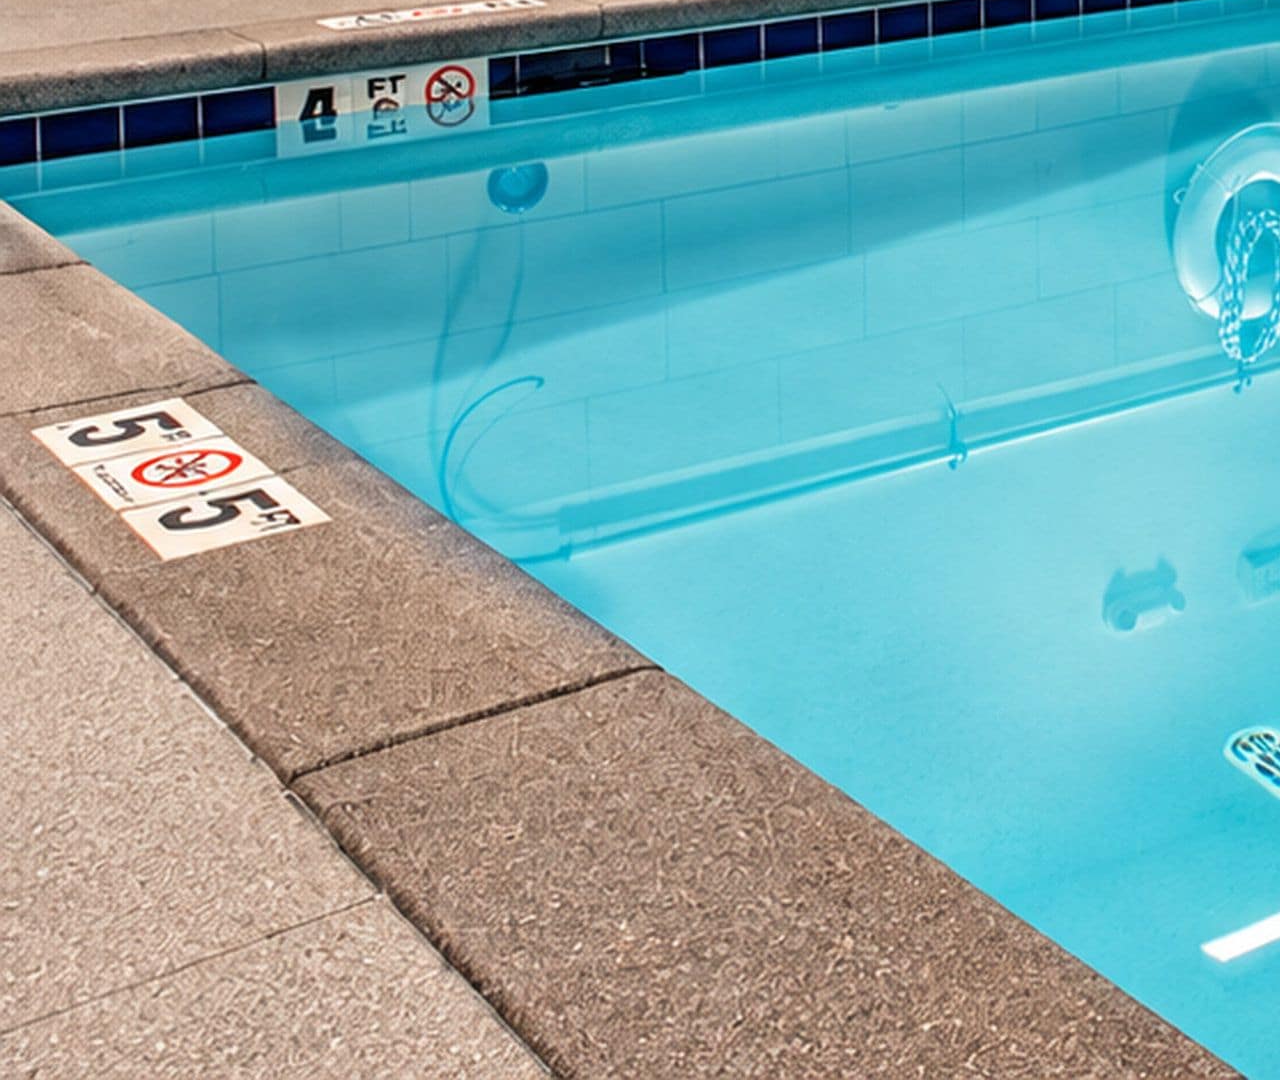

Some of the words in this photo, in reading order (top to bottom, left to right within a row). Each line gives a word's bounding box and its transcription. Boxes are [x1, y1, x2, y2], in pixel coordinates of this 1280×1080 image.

[299, 86, 338, 130] 4
[367, 74, 406, 99] FT
[68, 411, 183, 447] 5
[158, 488, 280, 531] 5
